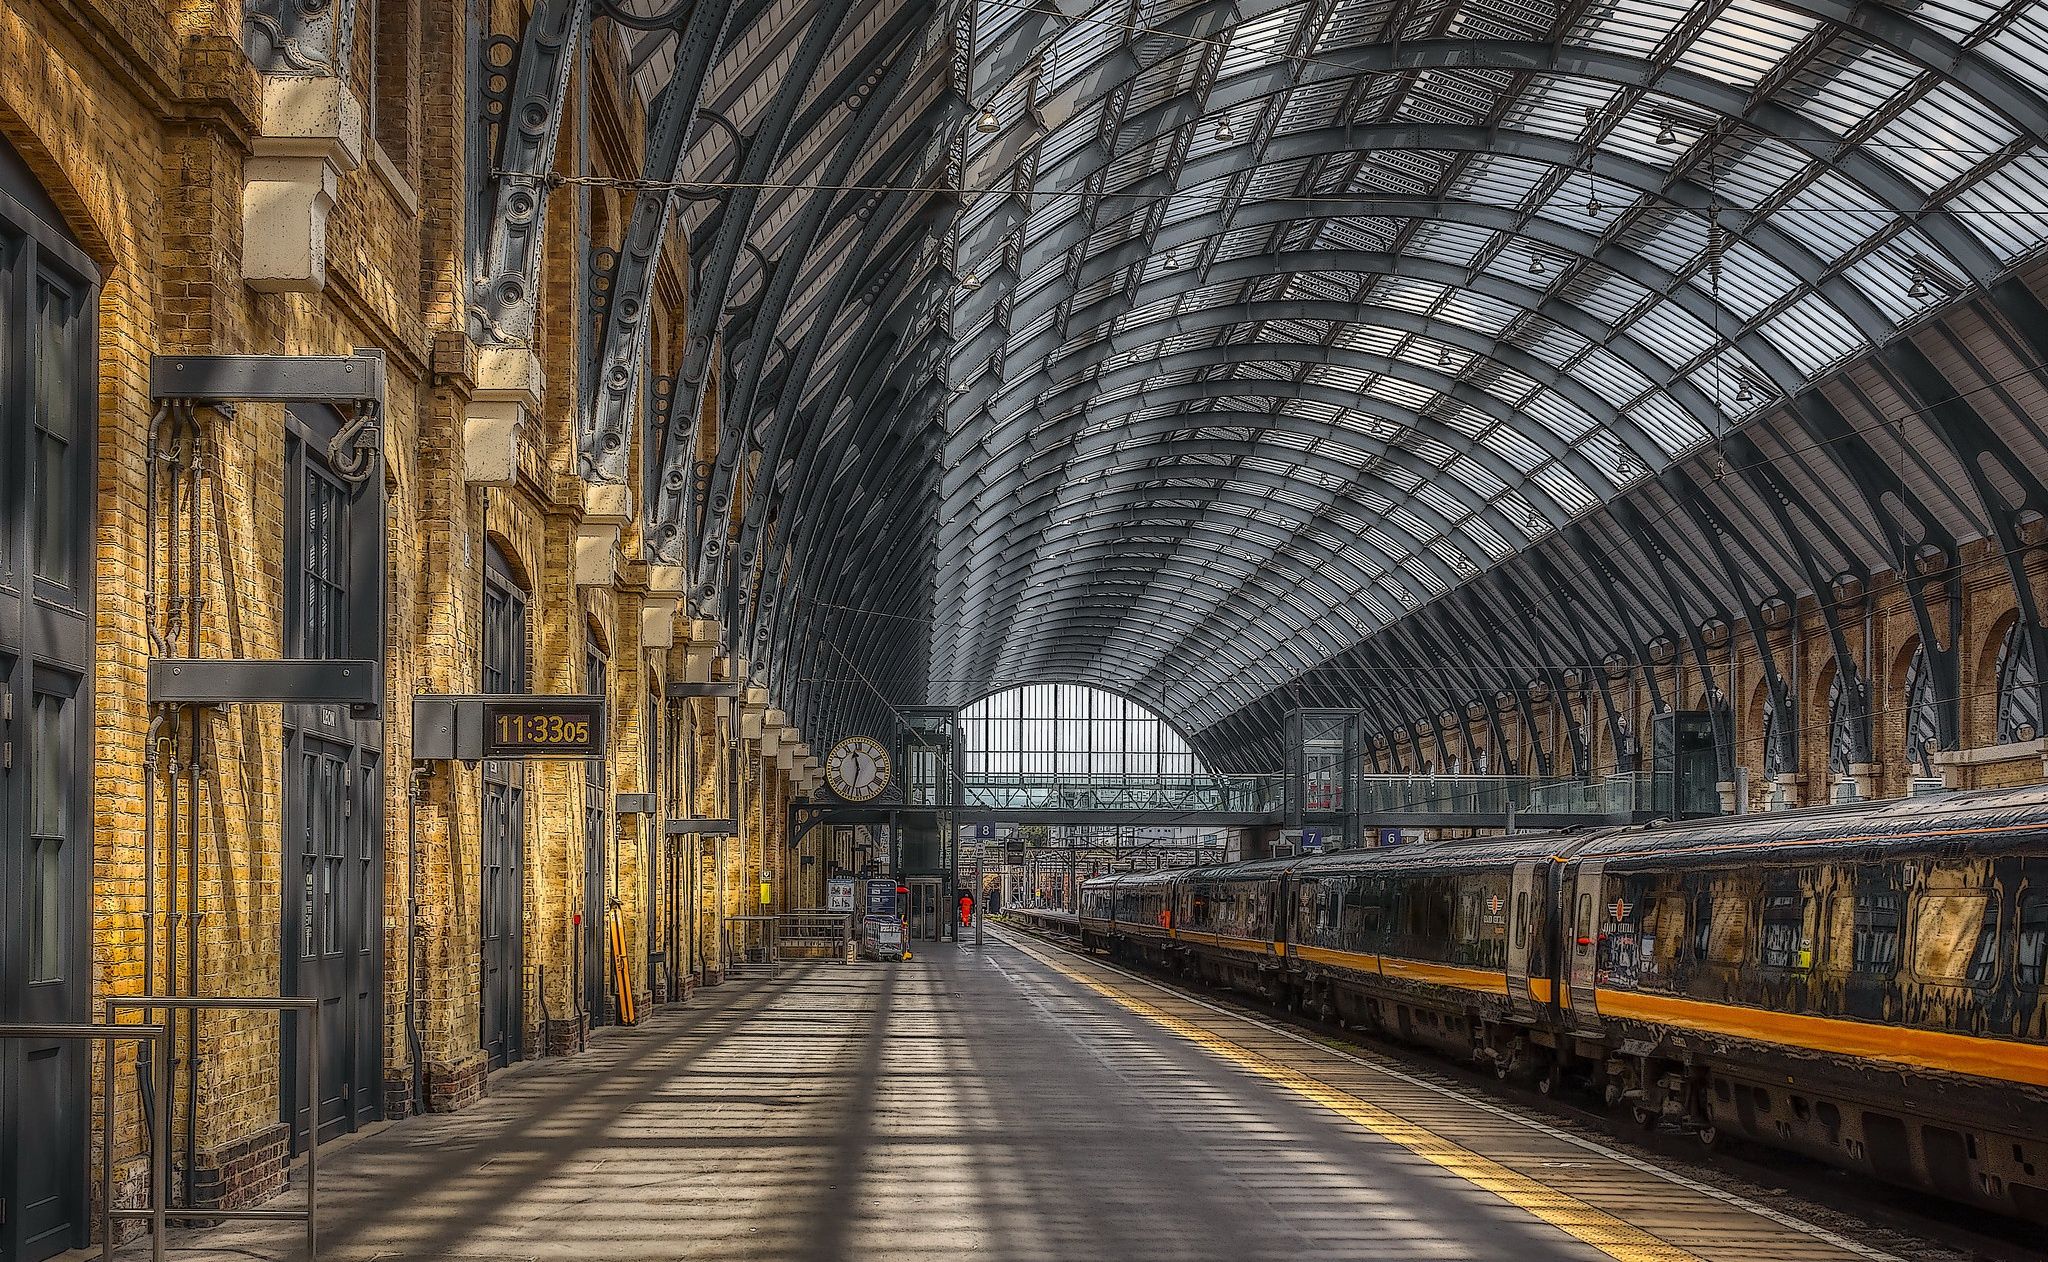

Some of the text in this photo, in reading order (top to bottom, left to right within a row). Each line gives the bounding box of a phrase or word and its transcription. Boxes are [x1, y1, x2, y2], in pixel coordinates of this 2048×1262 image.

[982, 825, 990, 836] 8
[1308, 833, 1316, 843] 7
[1388, 833, 1395, 843] 6
